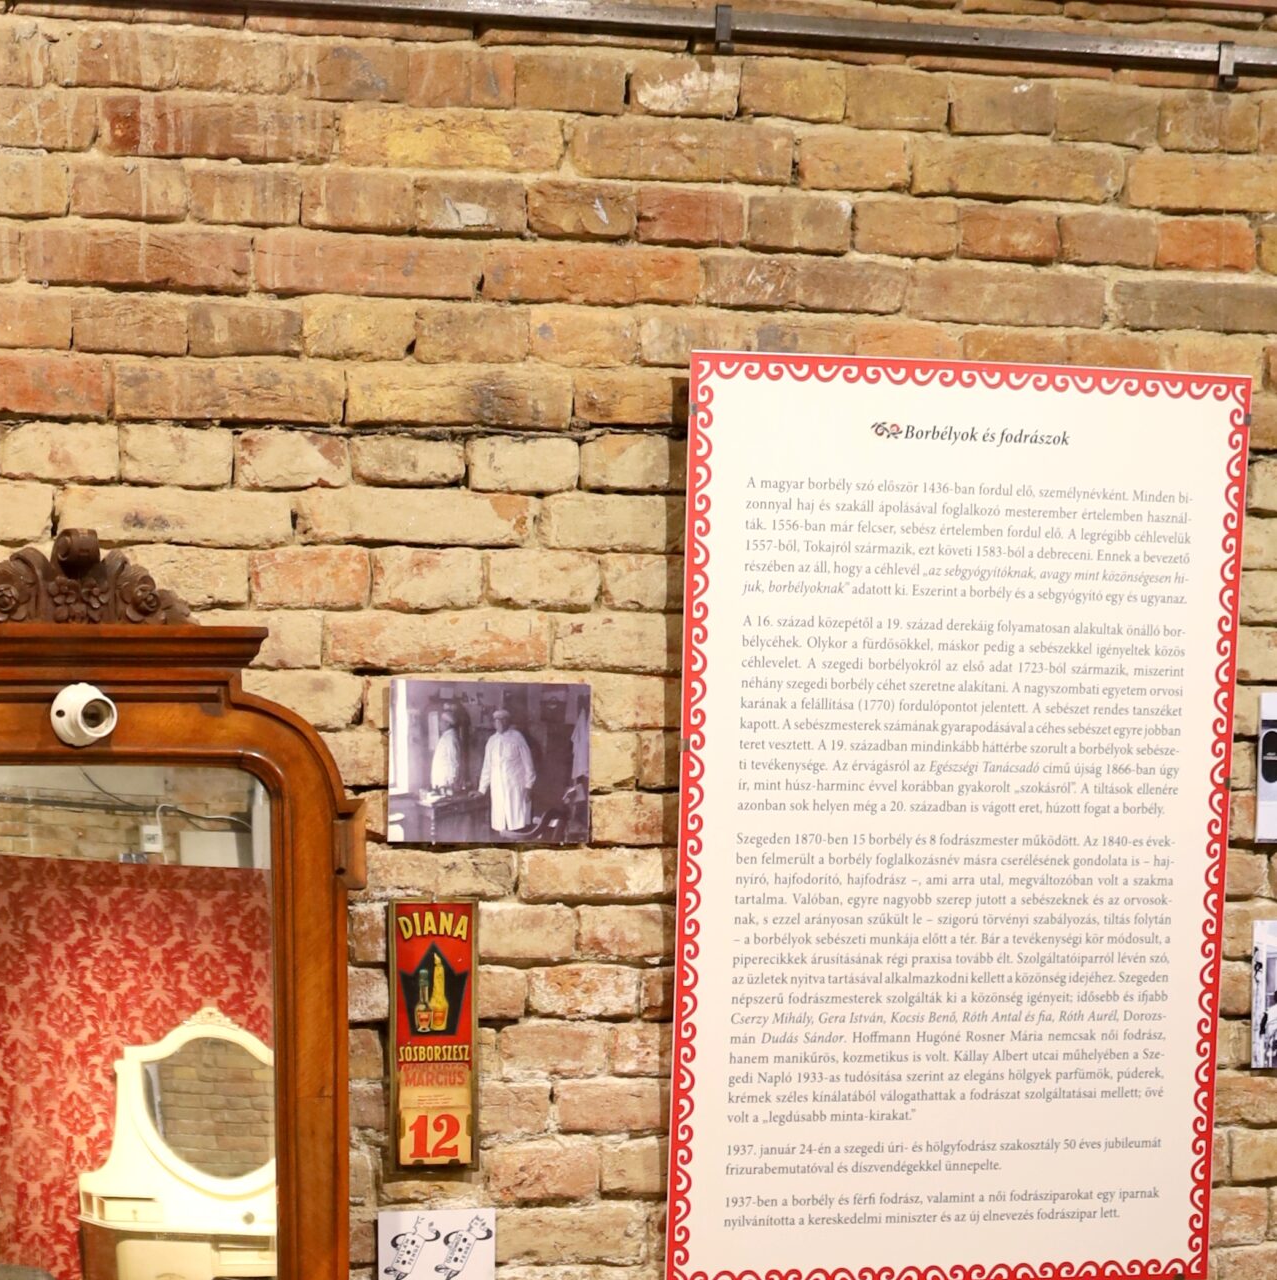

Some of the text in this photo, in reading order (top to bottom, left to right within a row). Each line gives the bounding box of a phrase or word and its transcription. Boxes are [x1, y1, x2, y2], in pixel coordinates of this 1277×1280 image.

[904, 424, 1070, 450] Borbélyok és fodrászok
[746, 476, 756, 488] A
[760, 479, 804, 493] magyar
[807, 476, 852, 494] borbély
[855, 479, 875, 491] szó
[877, 479, 918, 493] először
[978, 483, 1013, 496] fordul
[1132, 489, 1175, 503] Minden
[806, 635, 847, 652] Olykor
[937, 638, 979, 651] máskor
[983, 639, 1015, 656] pedig
[1018, 644, 1024, 652] a
[1028, 640, 1092, 654] sebészekkel
[1096, 643, 1150, 659] igényeltek
[1154, 644, 1185, 657] közös
[736, 832, 791, 848] Szegeden
[853, 833, 866, 844] 15
[868, 832, 912, 848] borbély
[914, 834, 927, 845] és
[929, 834, 936, 844] 8
[939, 833, 1019, 846] fodrászmester
[1083, 835, 1098, 846] Az
[397, 911, 469, 941] DIANA
[731, 992, 784, 1008] népszerű
[788, 991, 883, 1004] fodrászmesterek
[885, 991, 943, 1007] szolgálták
[946, 991, 957, 1002] ki
[970, 991, 1023, 1006] közönség
[1076, 990, 1120, 1002] idősebb
[1122, 993, 1134, 1001] és
[1137, 989, 1168, 1004] ifjabb
[730, 1033, 756, 1044] mán
[761, 1031, 798, 1043] Dudás
[852, 1030, 911, 1043] Hoffmann
[915, 1031, 961, 1046] Hugóné
[965, 1030, 1005, 1042] Rosner
[1010, 1030, 1043, 1041] Mária
[1047, 1029, 1096, 1041] nemcsak
[1100, 1029, 1118, 1040] női
[399, 1042, 470, 1062] SÓSBORSZESZ
[409, 1114, 460, 1158] 12
[725, 1161, 834, 1175] frizurabemutatóval
[836, 1162, 848, 1173] és
[850, 1159, 942, 1176] díszvendégekkel
[723, 1214, 796, 1230] nyilvánította
[798, 1217, 804, 1225] a
[807, 1212, 882, 1225] kereskedelmi
[885, 1212, 938, 1223] miniszter
[939, 1212, 951, 1222] és
[953, 1213, 966, 1222] az
[969, 1211, 980, 1224] új
[982, 1208, 1034, 1221] elnevezés
[1036, 1206, 1097, 1223] fodrászipar
